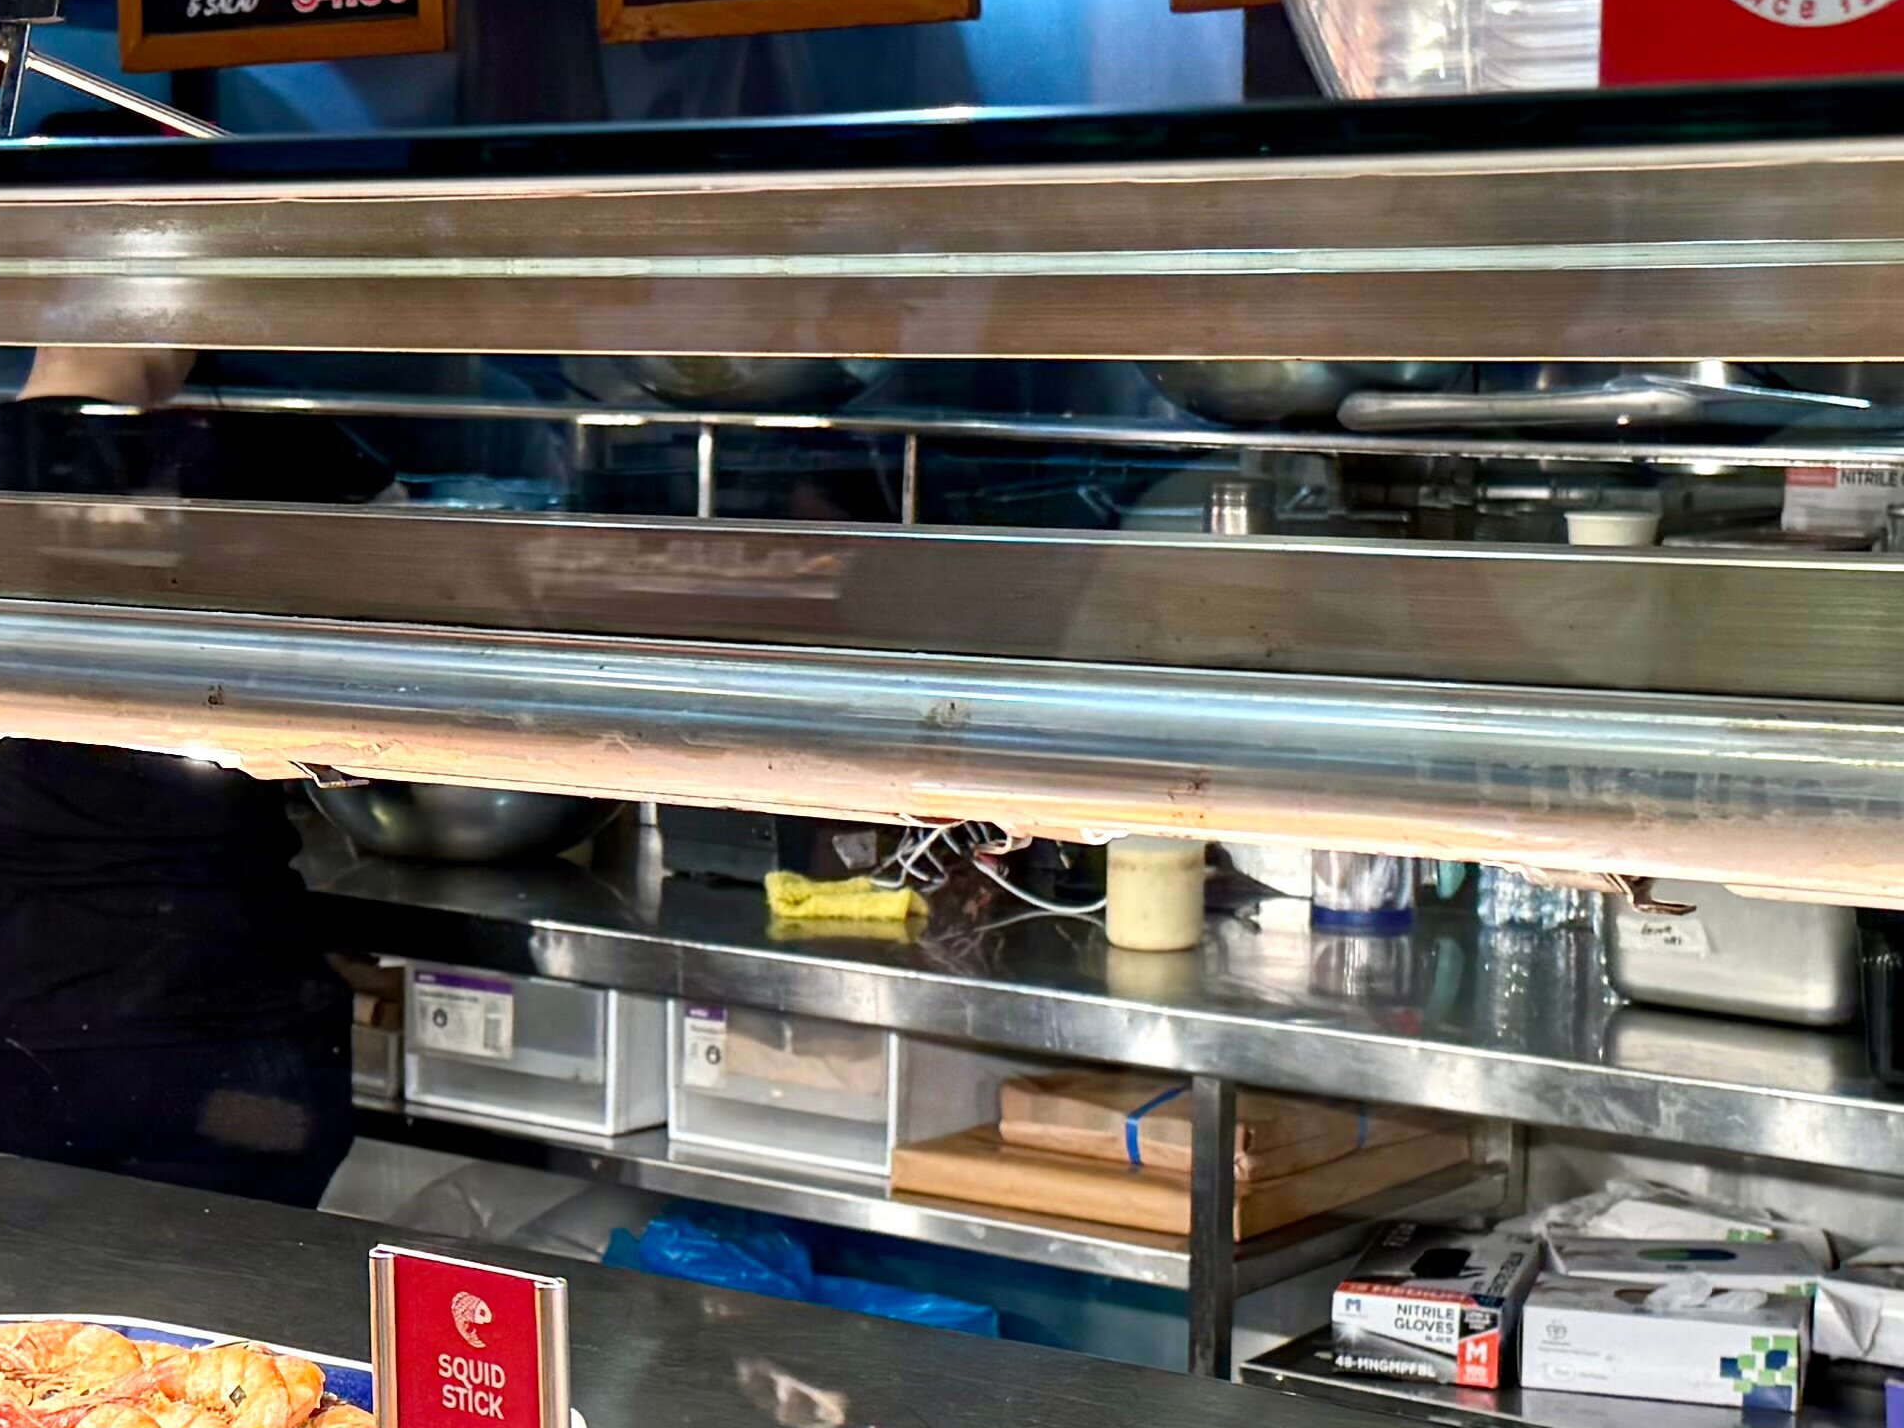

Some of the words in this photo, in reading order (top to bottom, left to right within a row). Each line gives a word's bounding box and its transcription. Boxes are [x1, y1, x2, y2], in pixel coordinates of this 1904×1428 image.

[1840, 470, 1897, 488] NITRILE
[1397, 1303, 1455, 1321] NITRILE
[1394, 1317, 1455, 1334] GLOVES
[1465, 1341, 1488, 1363] M
[437, 1353, 506, 1389] SQUID
[442, 1383, 505, 1421] STICK
